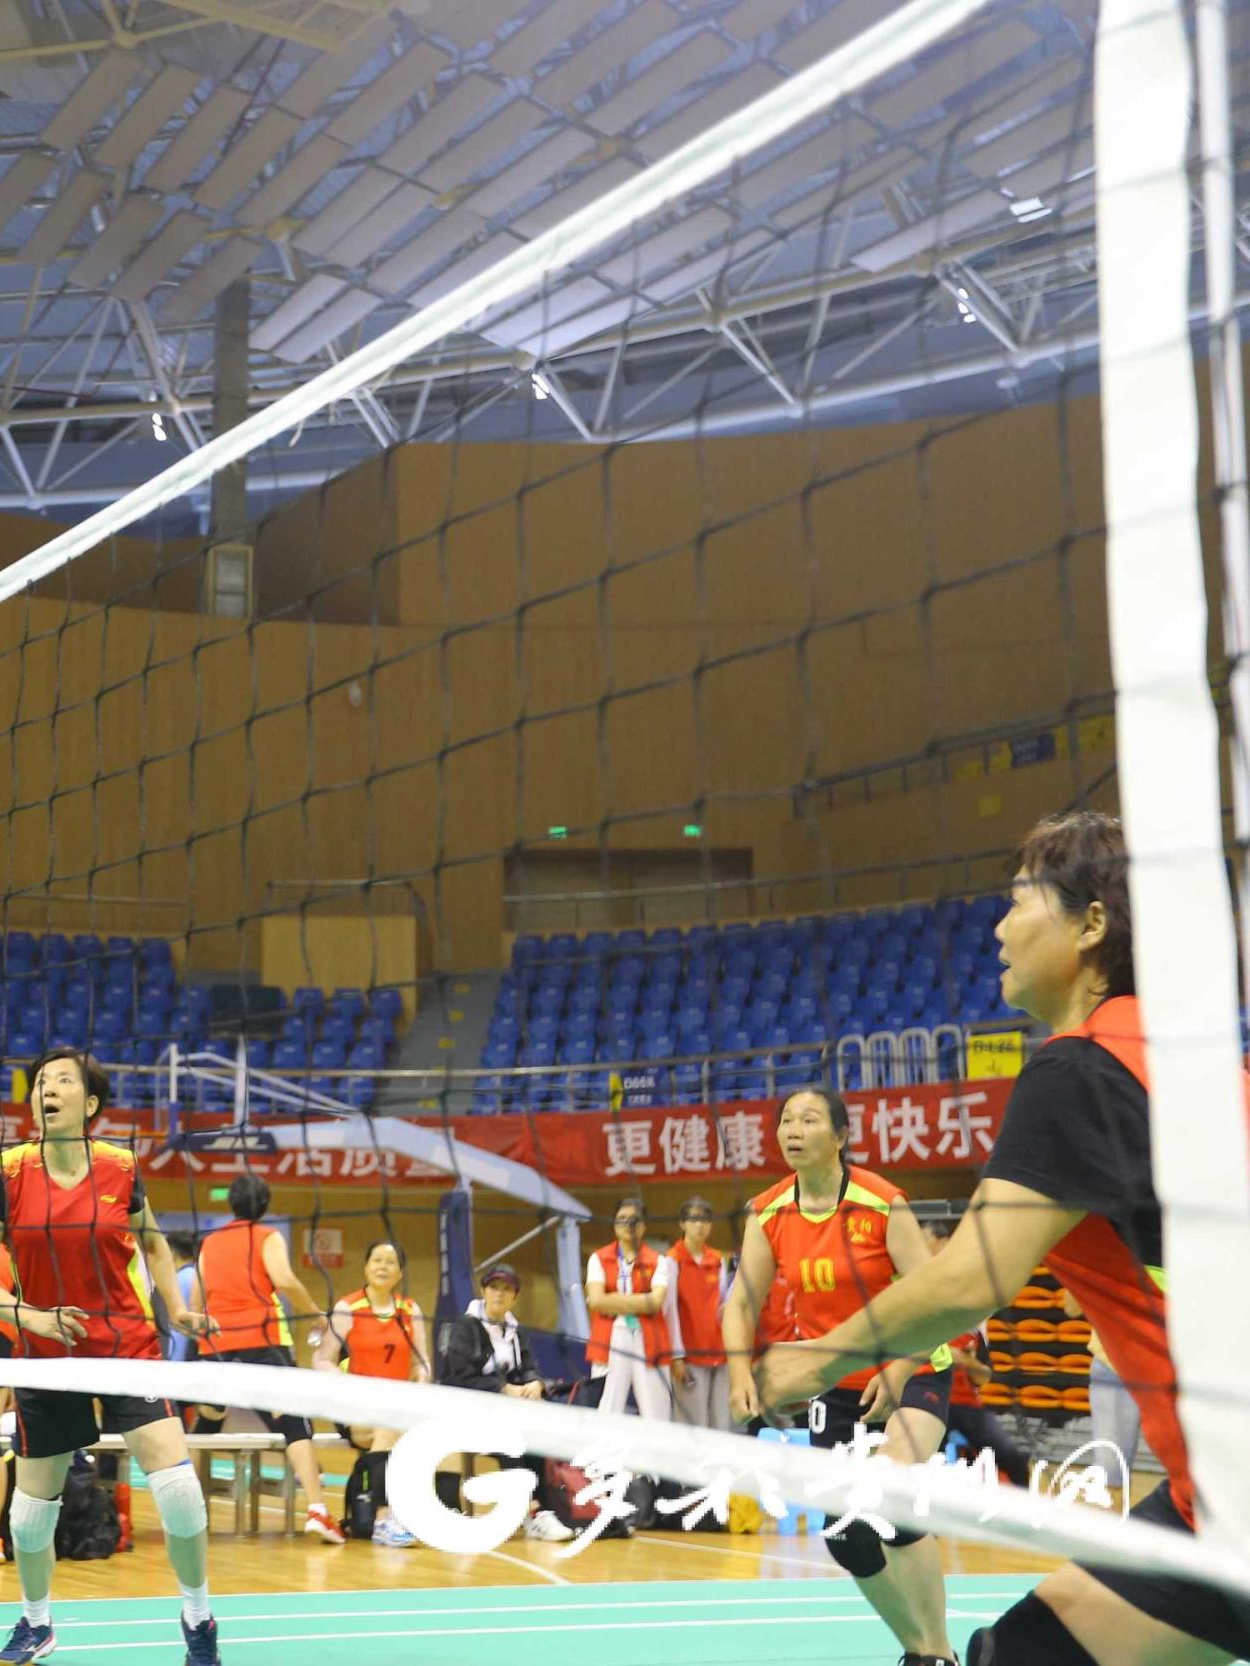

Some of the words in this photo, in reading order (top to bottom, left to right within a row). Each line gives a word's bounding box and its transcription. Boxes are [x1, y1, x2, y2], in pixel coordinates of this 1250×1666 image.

[799, 1257, 835, 1292] 10
[383, 1344, 395, 1364] 7
[808, 1400, 827, 1434] 0
